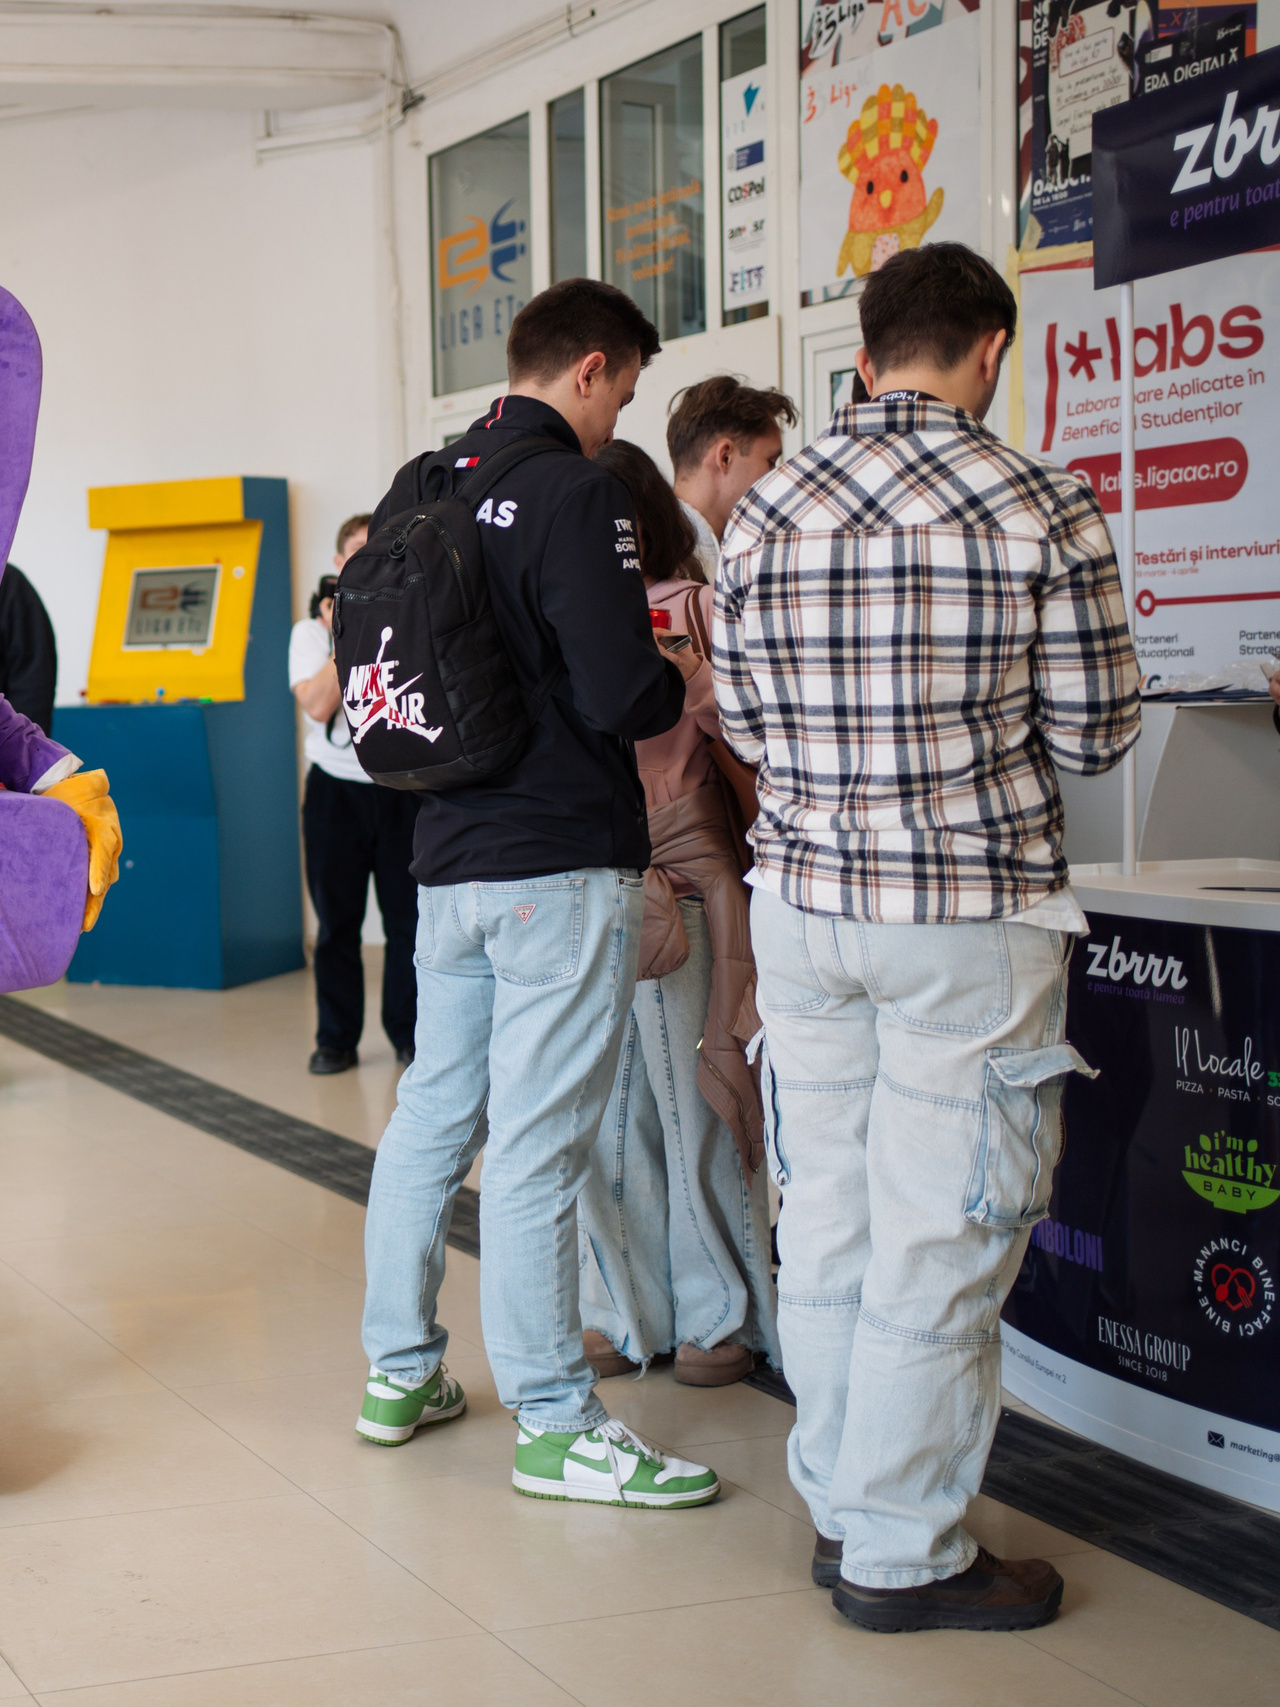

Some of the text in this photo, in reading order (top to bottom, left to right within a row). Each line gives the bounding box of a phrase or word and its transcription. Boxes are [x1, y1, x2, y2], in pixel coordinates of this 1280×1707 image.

[838, 3, 864, 34] Liga
[1144, 72, 1170, 94] ERA
[1170, 210, 1179, 227] e
[1183, 193, 1240, 230] pentru
[440, 304, 484, 352] LIGA
[1066, 368, 1265, 417] Laboraare Aplicate în
[1062, 401, 1243, 442] Beneficl Studenților
[476, 498, 518, 528] AS
[1135, 539, 1280, 567] Testări și interviuri
[1135, 646, 1195, 660] ducaționali
[346, 660, 395, 702] NIKE
[386, 692, 427, 730] AIR
[1086, 935, 1188, 990] zbrrr
[1094, 983, 1123, 996] pentru
[1176, 1079, 1204, 1094] PIZZA
[1217, 1087, 1251, 1102] PASTA
[1184, 1144, 1278, 1188] healthy
[1203, 1180, 1256, 1201] BABY
[1031, 1217, 1104, 1273] MBOLONI
[1193, 1237, 1275, 1301] MANANCI BINE
[1198, 1295, 1272, 1337] FACI BINE
[1098, 1315, 1191, 1372] ENESSA GROUP
[1118, 1354, 1168, 1382] SINCE 2018
